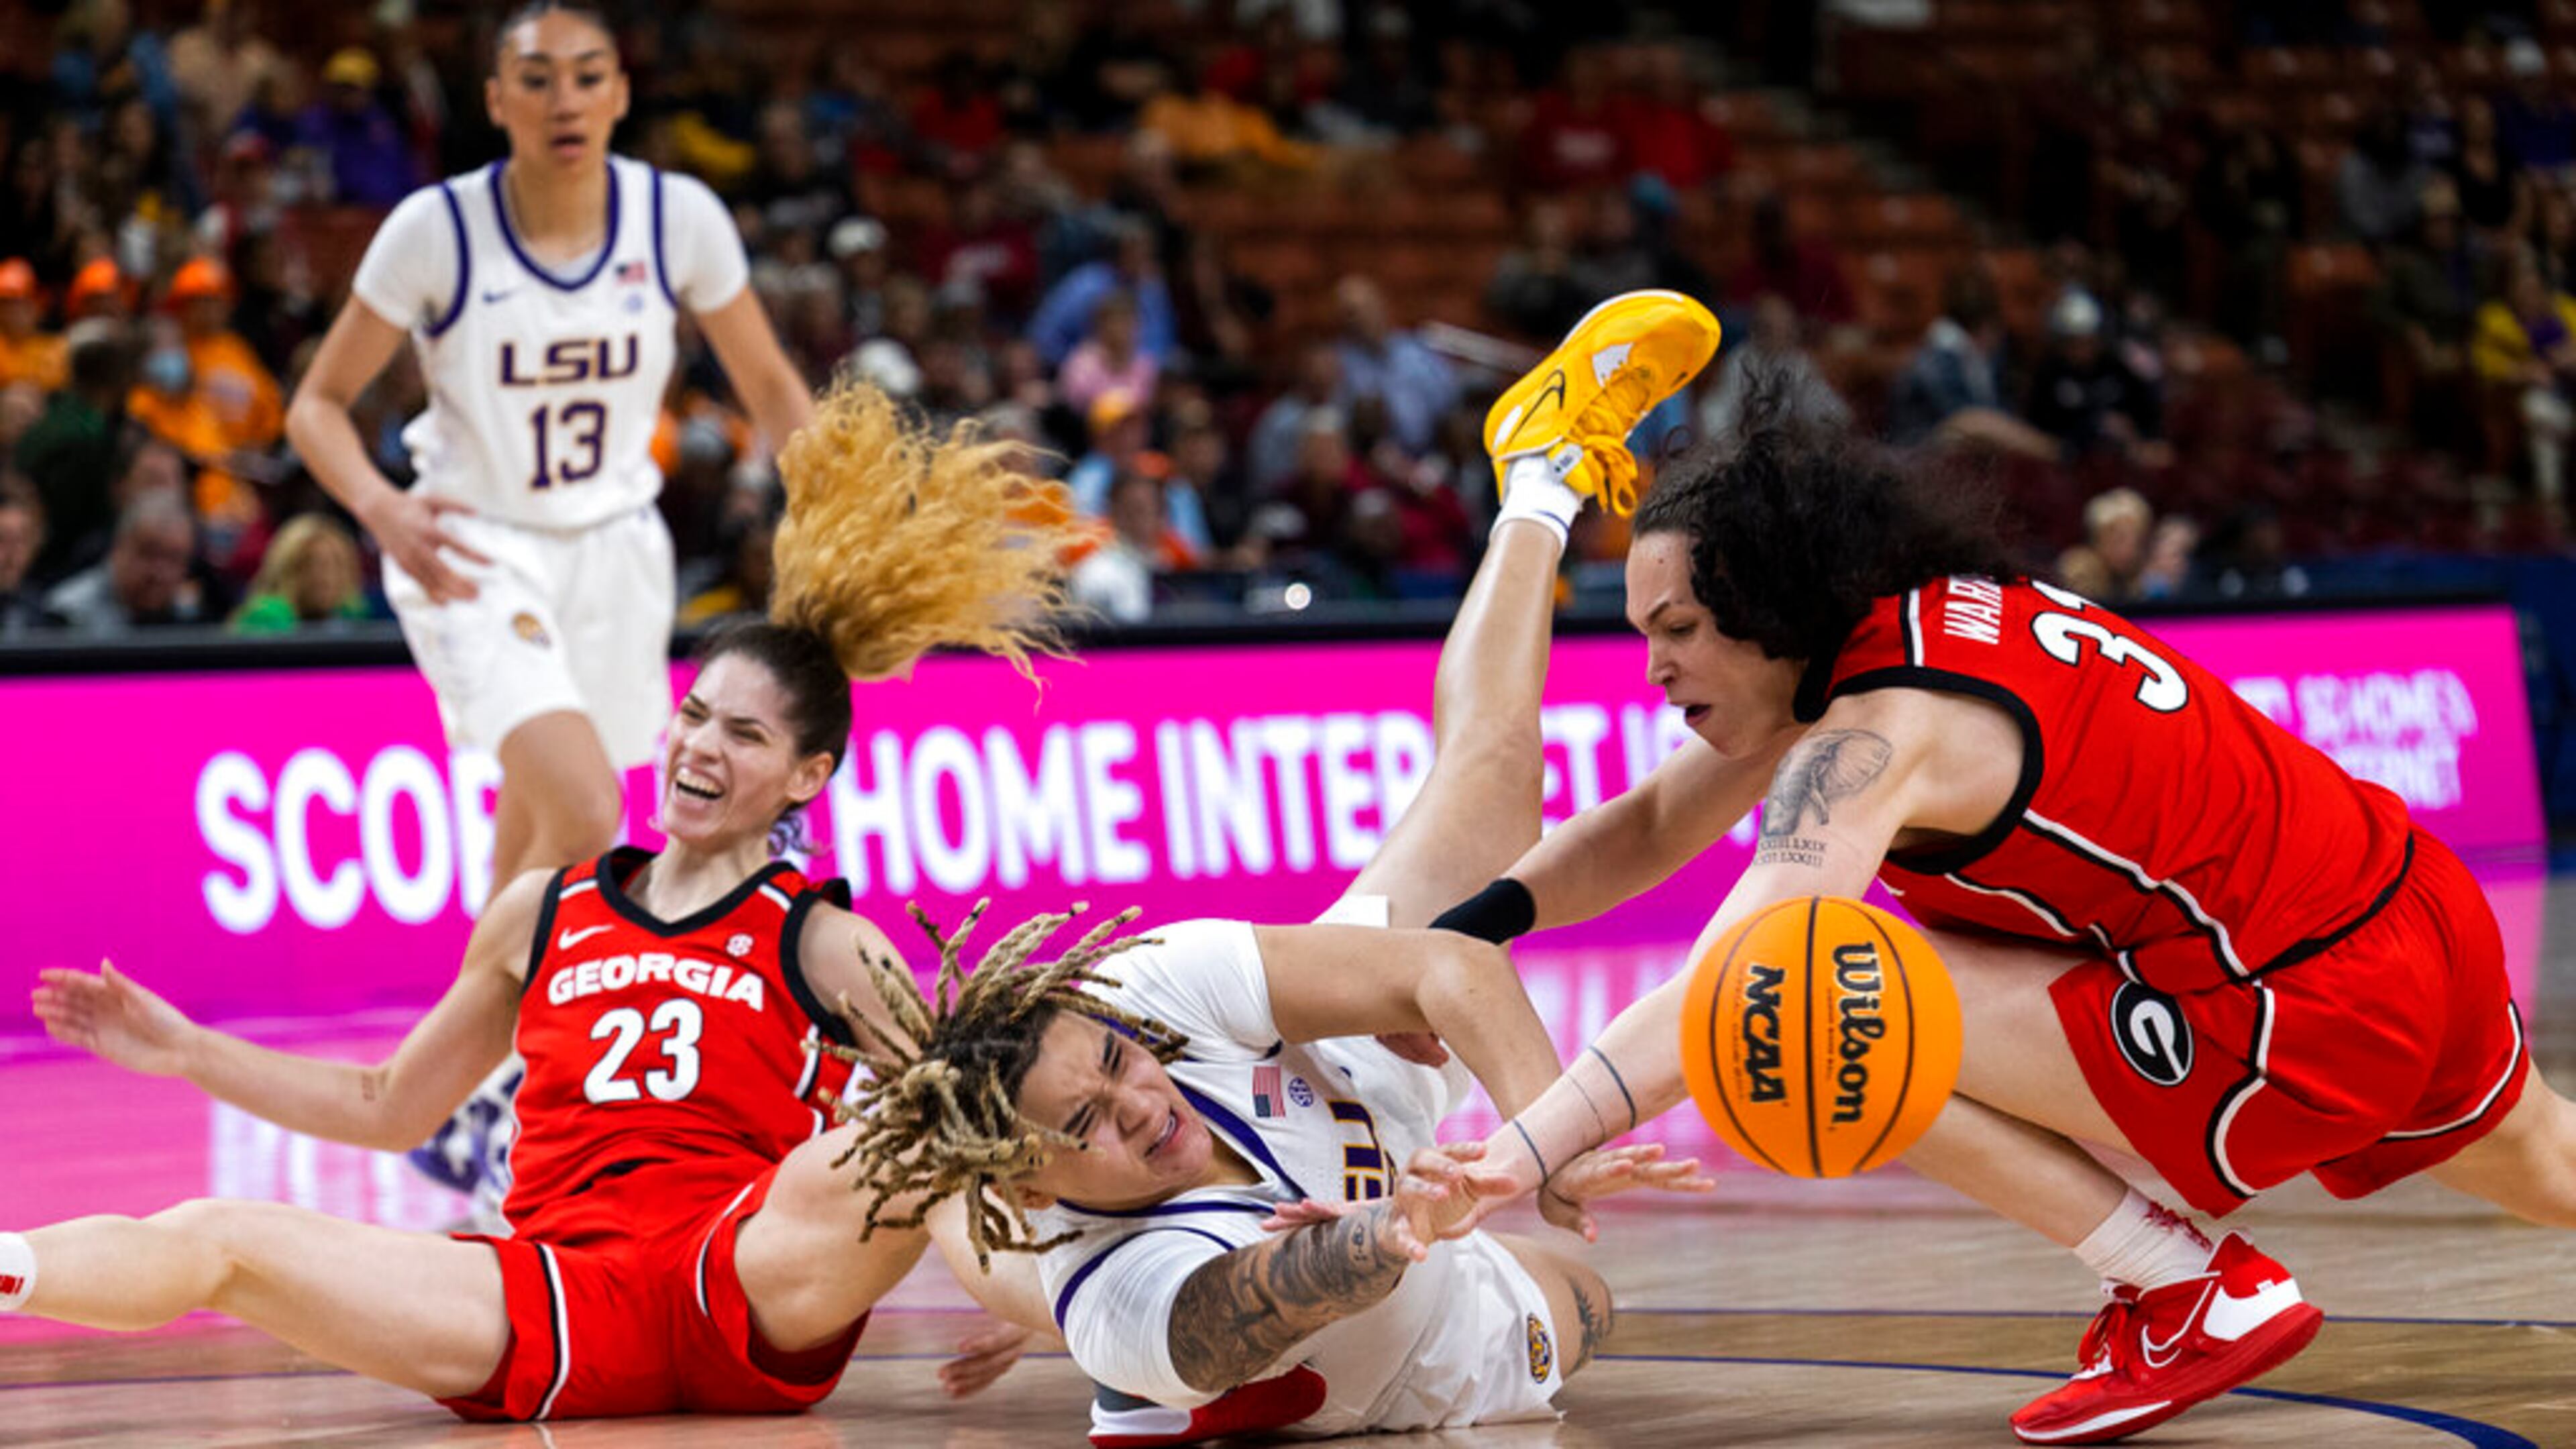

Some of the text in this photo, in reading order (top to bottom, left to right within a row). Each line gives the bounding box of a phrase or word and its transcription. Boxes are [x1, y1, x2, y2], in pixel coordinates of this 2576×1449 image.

[498, 333, 639, 388] LSU
[529, 398, 608, 490] 13
[1944, 576, 2002, 645] WAR
[830, 718, 1152, 900] HOME
[1155, 708, 1610, 884] INTERT
[547, 952, 765, 1012] GEORGIA
[583, 997, 703, 1106] 23
[1743, 964, 1787, 1104] NCAA
[1831, 941, 1886, 1125] Wilson
[2127, 996, 2188, 1084] G
